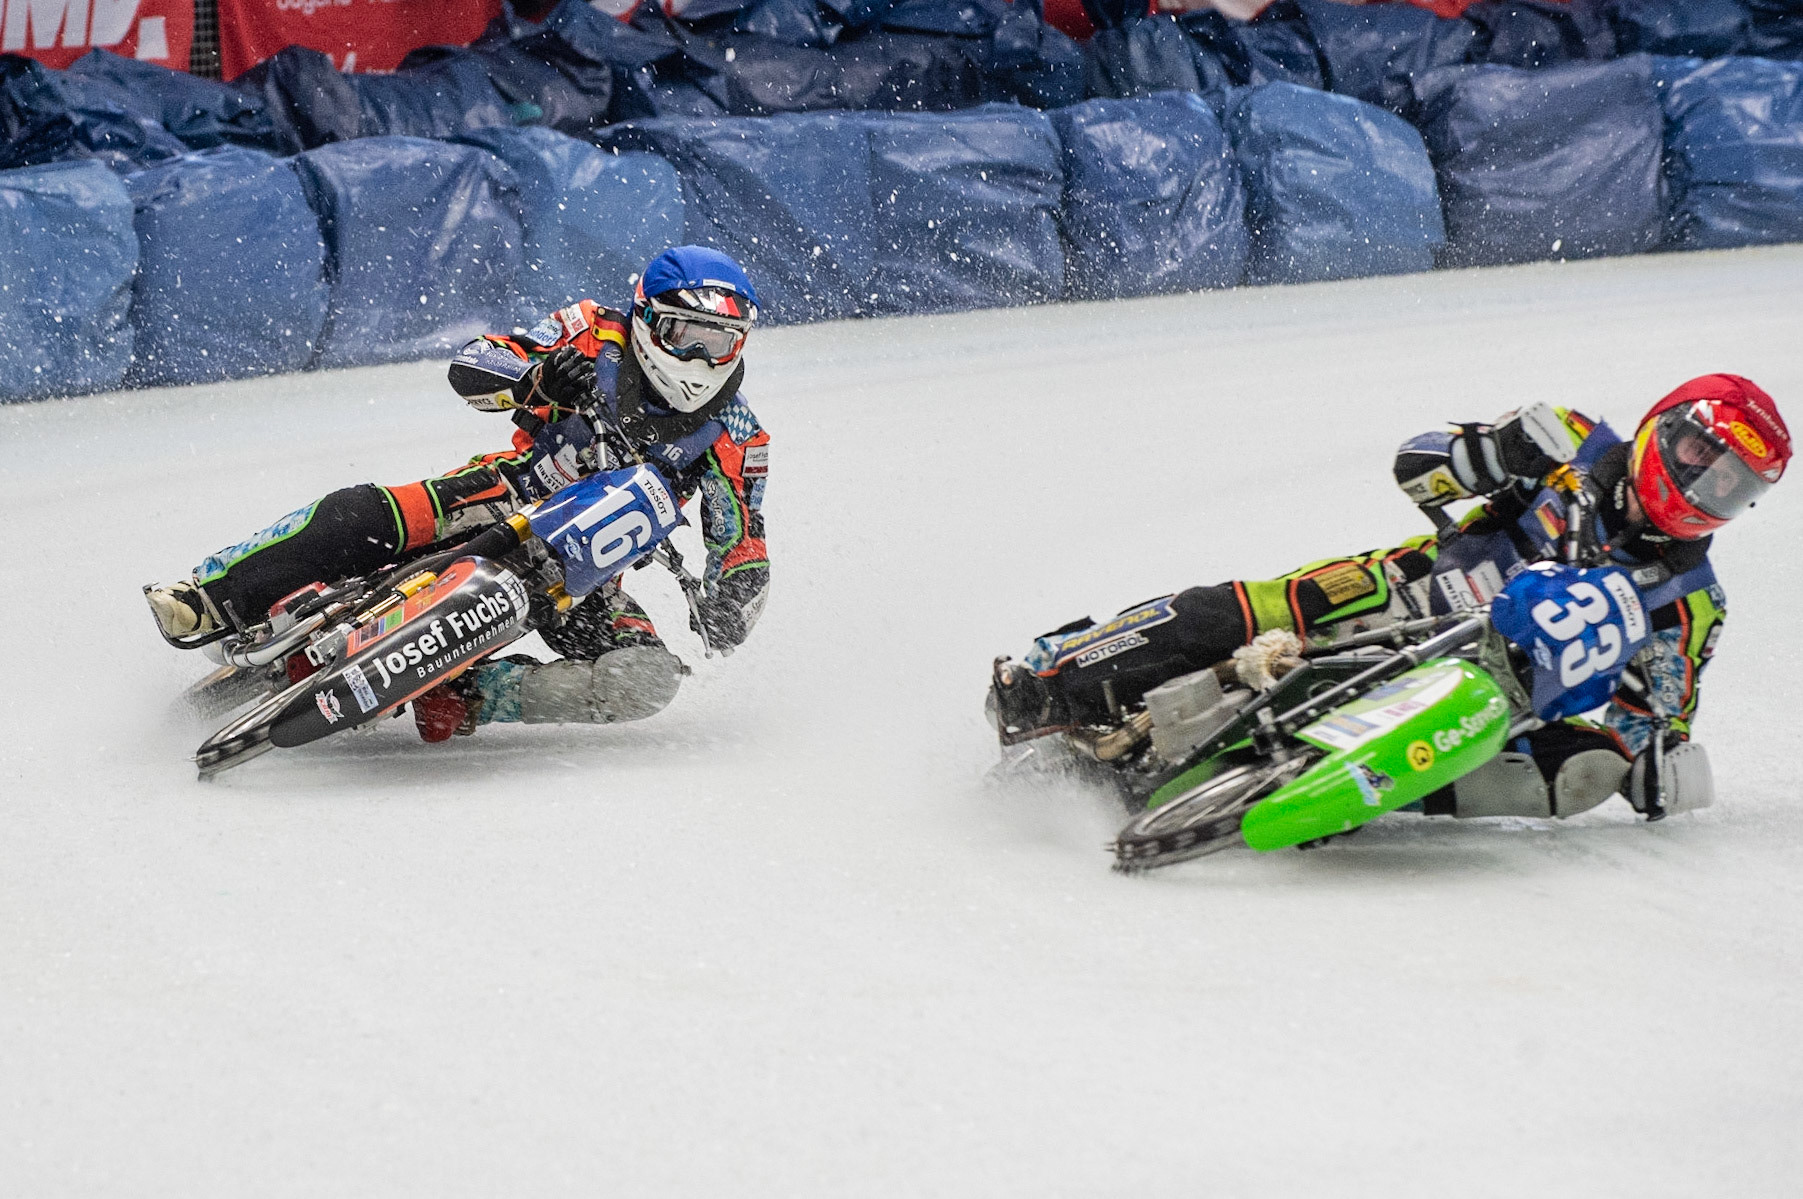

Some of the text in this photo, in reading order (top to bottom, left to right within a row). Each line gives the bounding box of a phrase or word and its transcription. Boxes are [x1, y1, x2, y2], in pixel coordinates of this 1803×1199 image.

[661, 443, 684, 462] 16
[574, 484, 652, 569] 16
[644, 479, 668, 516] TISSOT
[372, 619, 448, 690] Josef
[446, 589, 511, 640] Fuchs
[416, 614, 516, 679] Bauunternehmen
[1531, 581, 1623, 689] 33
